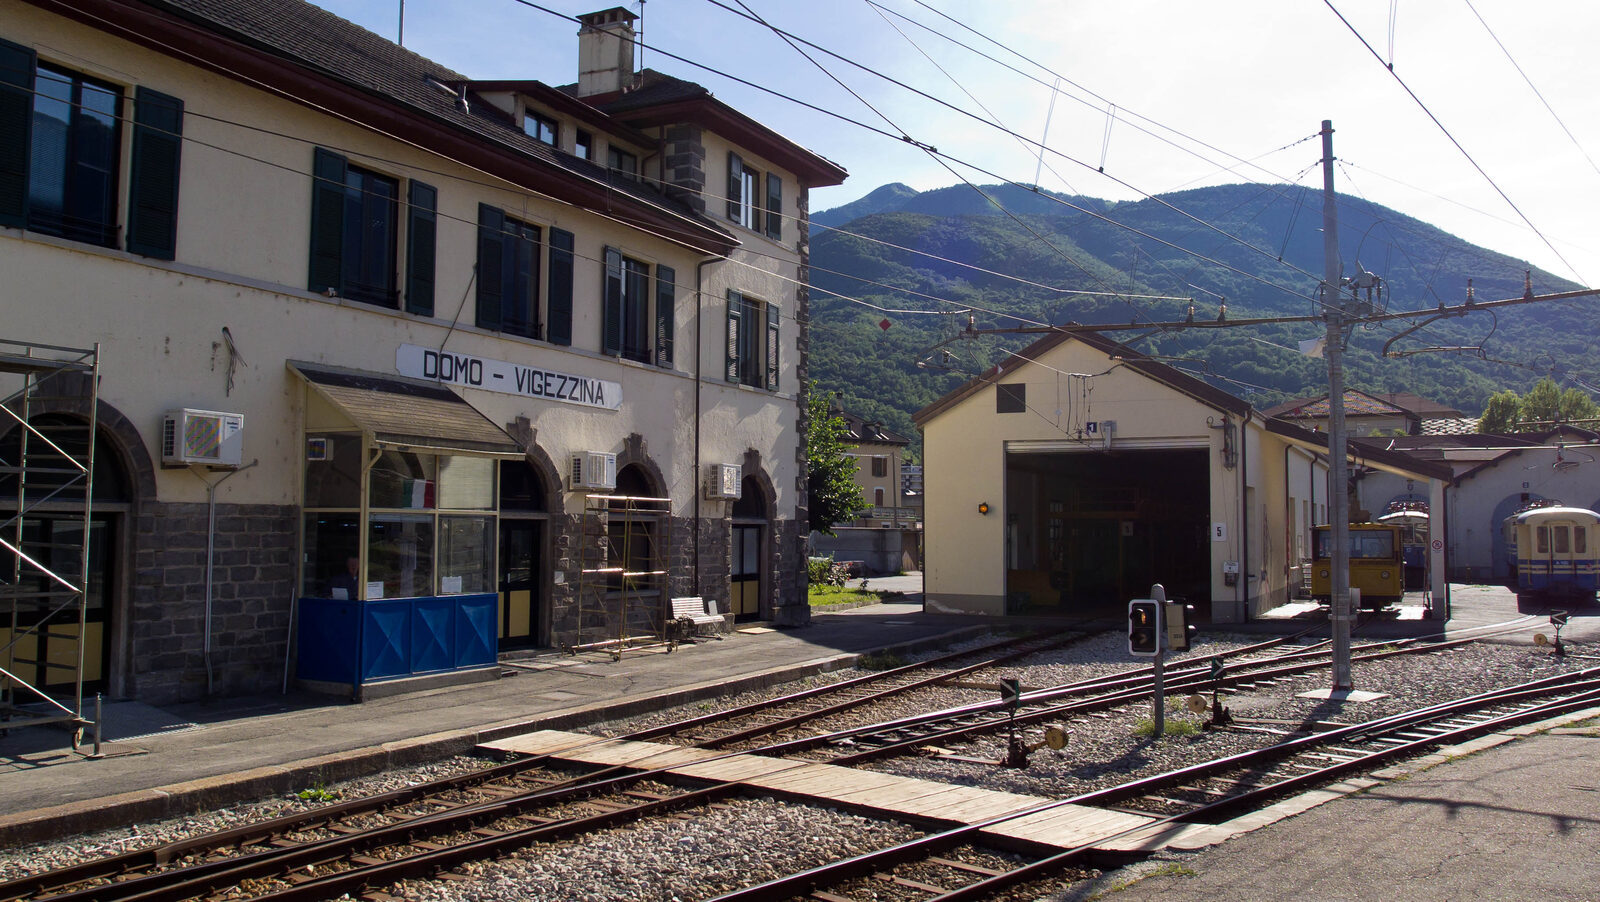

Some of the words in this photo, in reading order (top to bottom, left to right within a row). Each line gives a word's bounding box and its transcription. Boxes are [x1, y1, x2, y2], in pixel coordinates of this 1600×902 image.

[423, 350, 483, 386] DOMO
[515, 366, 605, 405] VIGEZZINA
[1217, 526, 1222, 537] 5
